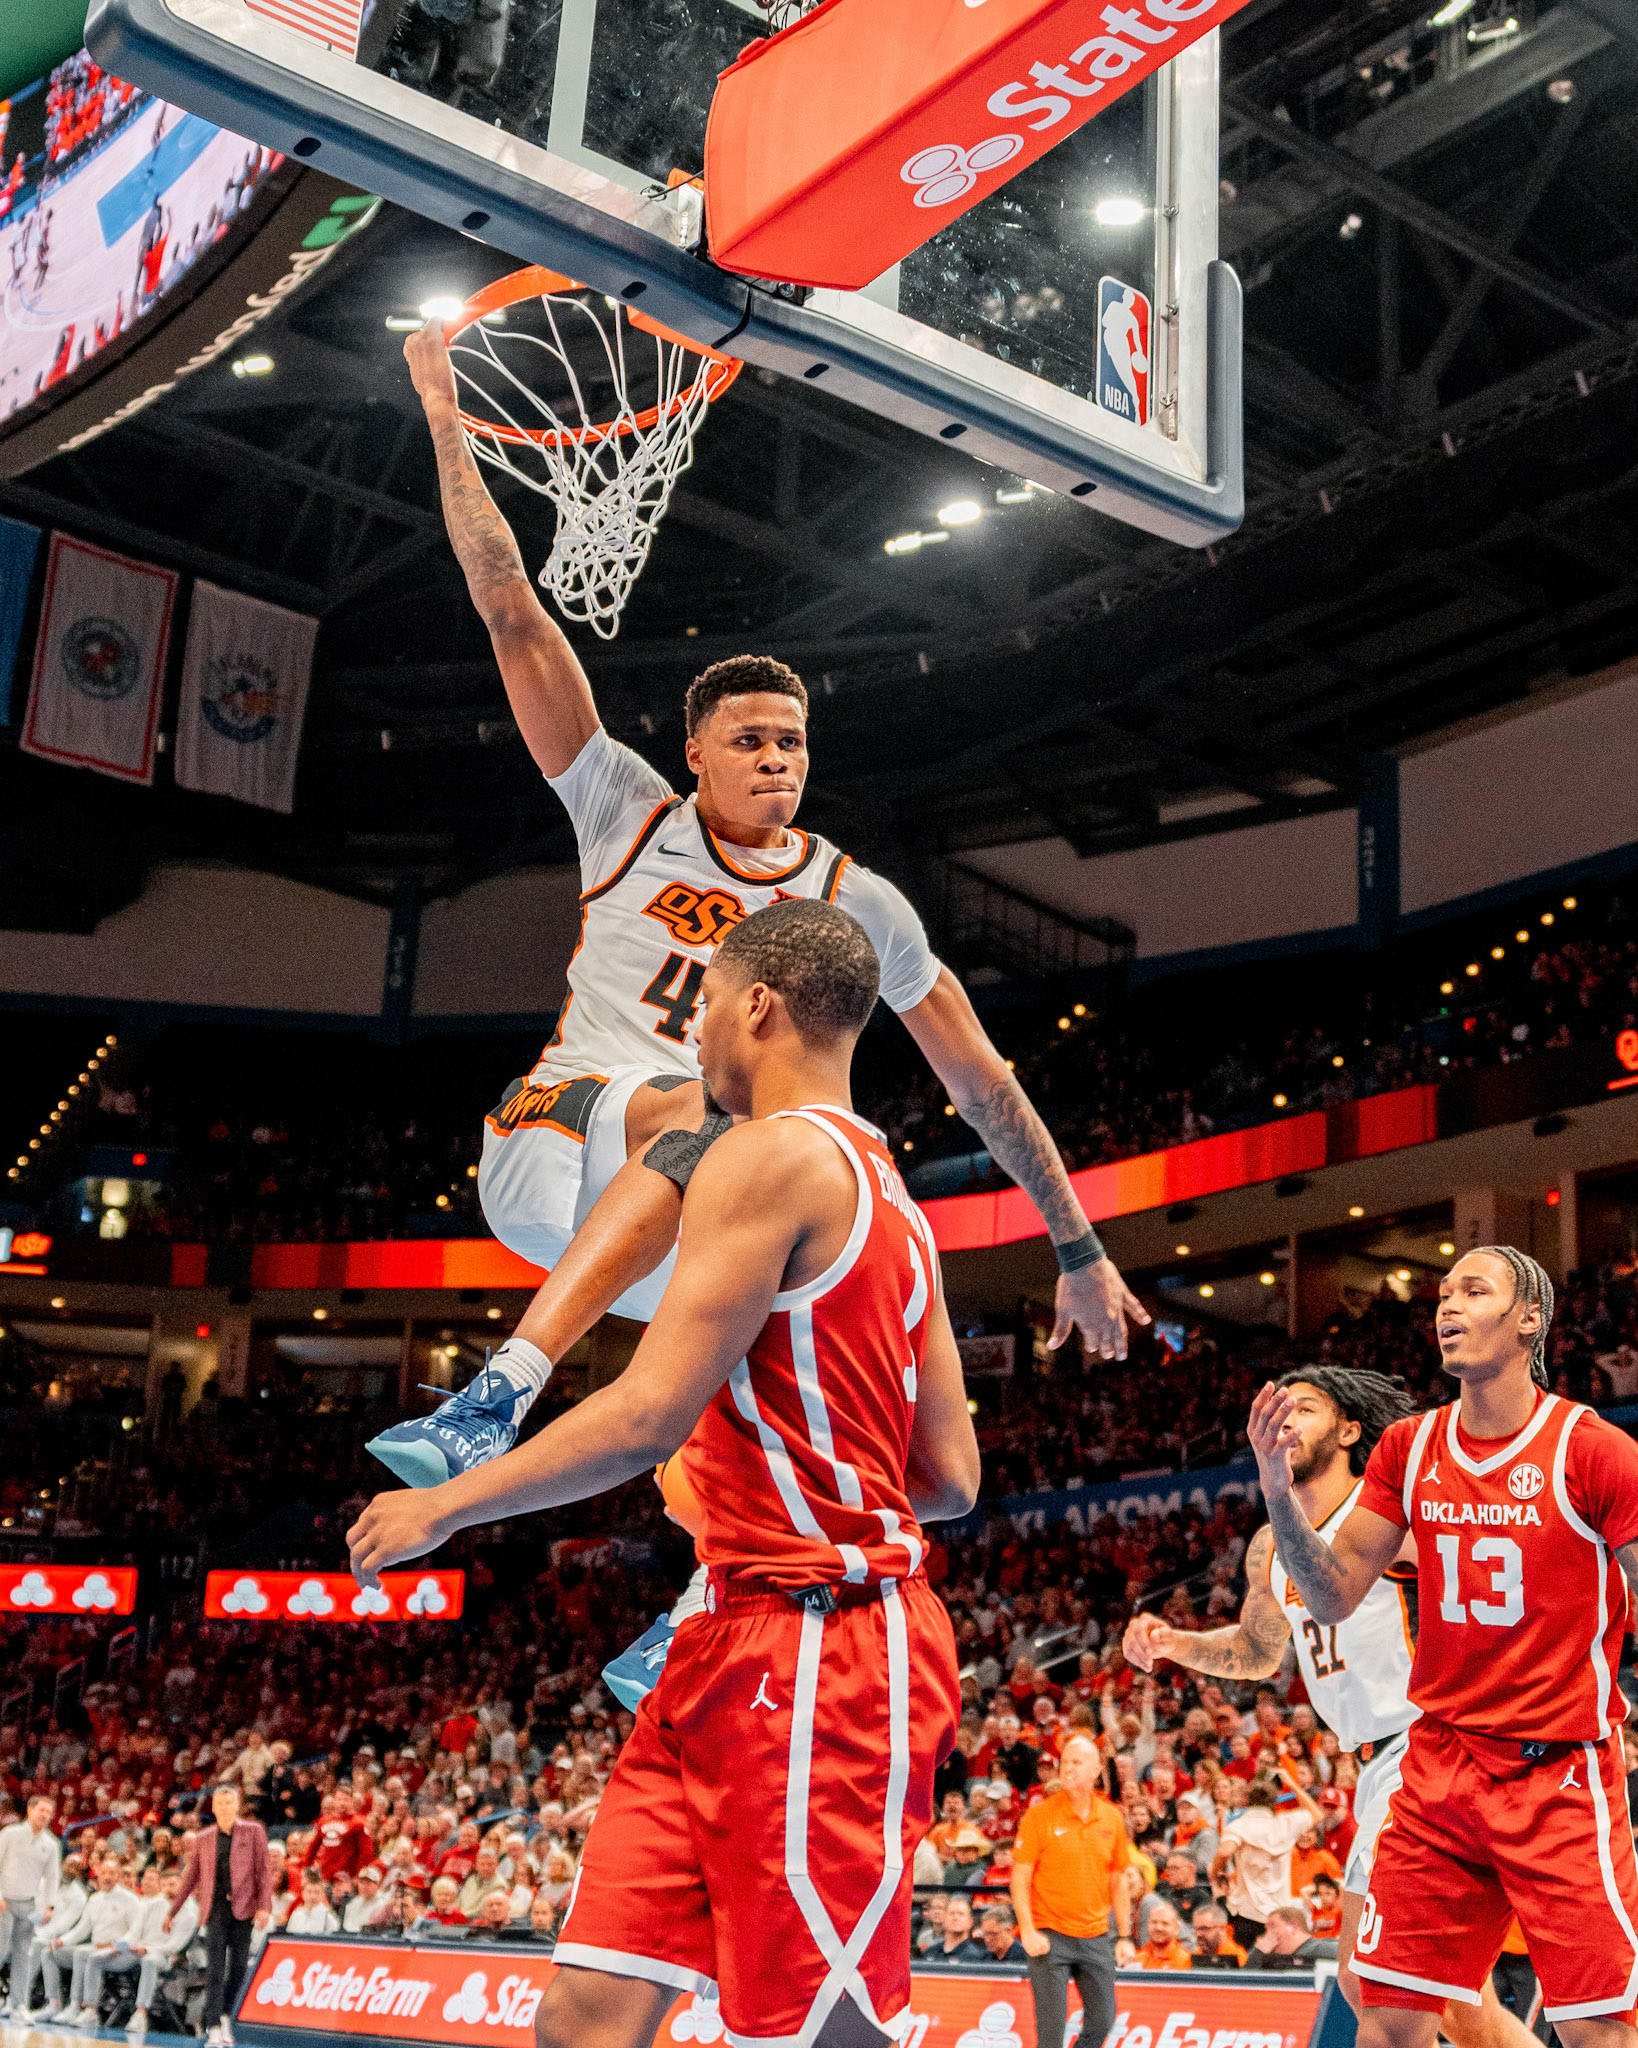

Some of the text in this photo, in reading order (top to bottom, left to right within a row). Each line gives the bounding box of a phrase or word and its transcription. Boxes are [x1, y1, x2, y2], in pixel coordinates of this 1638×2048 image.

[1105, 383, 1130, 416] NBA
[1511, 1465, 1541, 1497] SEC
[1420, 1500, 1542, 1527] OKLAHOMA
[1436, 1534, 1525, 1627] 13
[1302, 1617, 1346, 1680] 21
